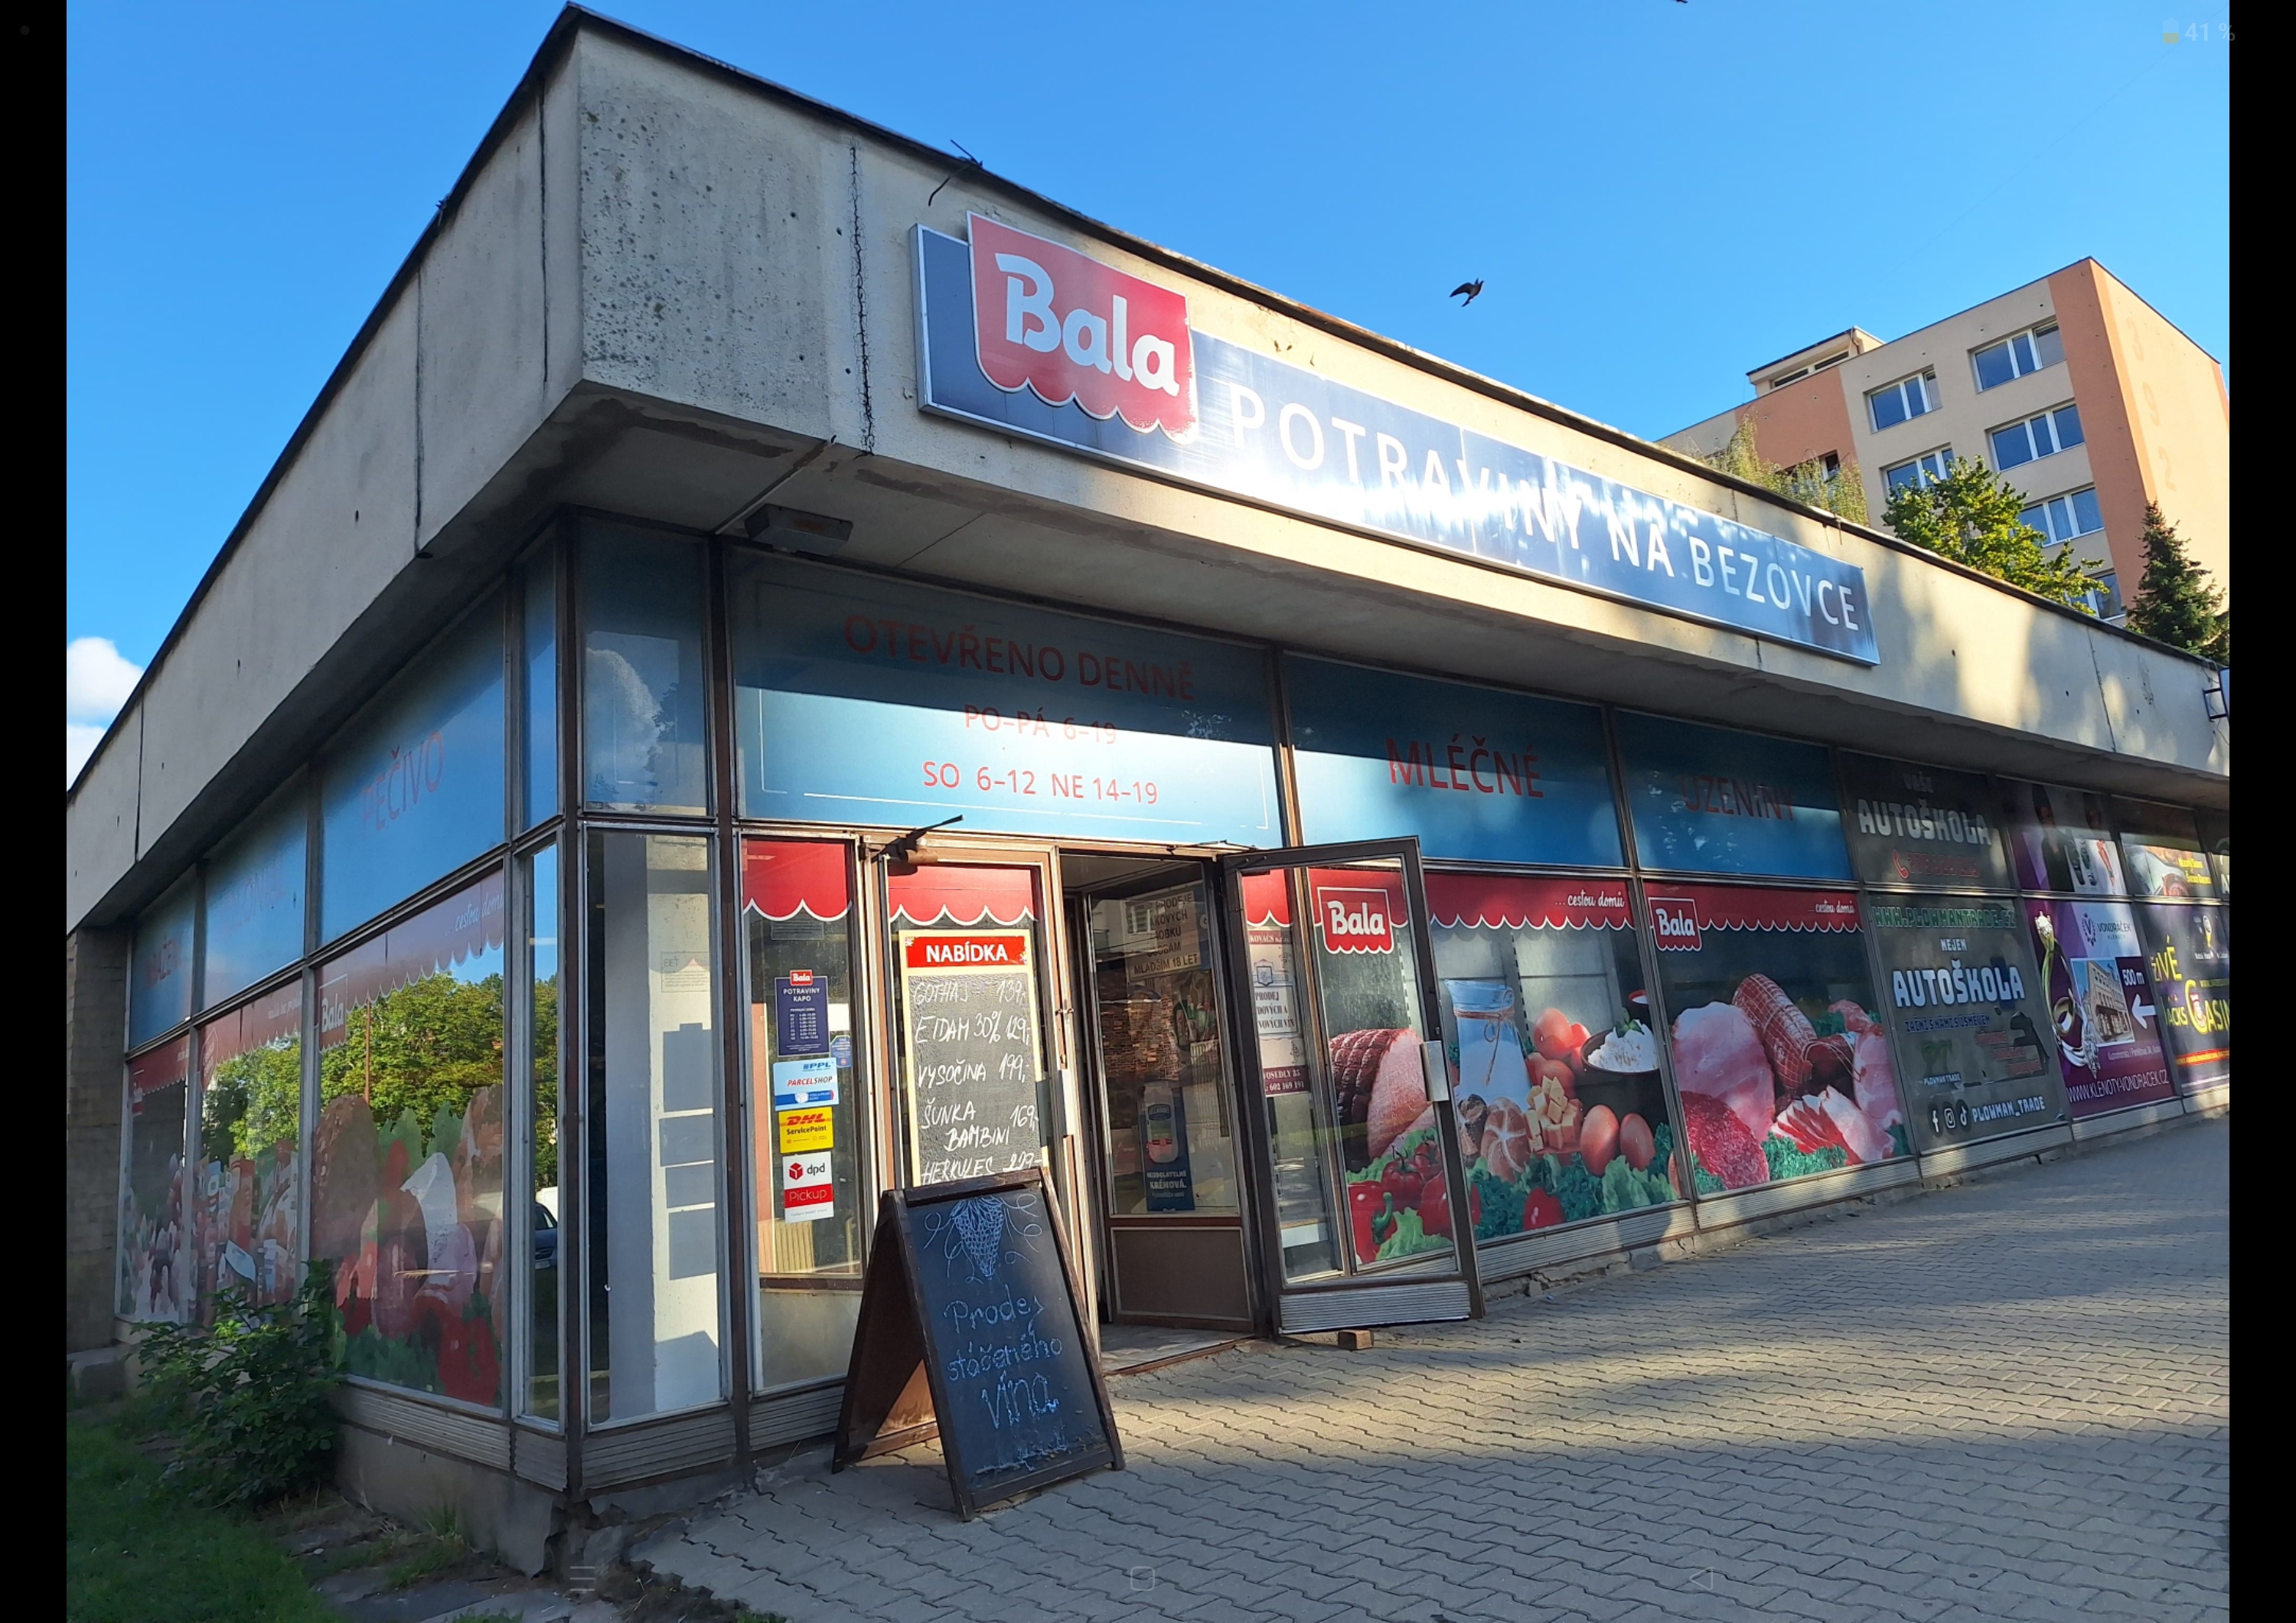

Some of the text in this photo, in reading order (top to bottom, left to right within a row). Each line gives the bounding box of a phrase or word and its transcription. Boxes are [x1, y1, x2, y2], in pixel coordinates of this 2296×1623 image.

[995, 252, 1180, 397] Bala
[1228, 381, 1859, 631] POTRAVINY NA BEZOVCE
[844, 615, 1195, 700] OTEVŘENO DENNĚ
[1386, 733, 1544, 798] MLÉČNÉ
[362, 731, 444, 840] PEČIVO
[921, 760, 1159, 805] SO 6-12 NE 14-19
[1681, 773, 1793, 821] UZENINY
[1857, 798, 1991, 846] AUTOŠKOLA
[1326, 900, 1386, 935] Bala
[1655, 908, 1696, 936] Bala
[925, 941, 1009, 963] NABÍDKA
[1940, 938, 1968, 951] NEJEN
[1172, 956, 1182, 968] 18
[1182, 953, 1199, 965] LET
[792, 972, 810, 981] Bala
[1893, 959, 2026, 1007] AUTOŠKOLA
[2122, 968, 2144, 986] 500 m
[913, 980, 969, 1004] GOTHAJ
[321, 993, 344, 1033] Bala
[915, 1015, 970, 1043] EIDAM
[974, 1010, 1002, 1044] 30%
[788, 1076, 833, 1086] PARCELSHOP
[918, 1058, 987, 1089] VYSOČINA
[787, 1113, 827, 1126] DHL
[921, 1097, 977, 1129] ŠUNKA
[1971, 1096, 2046, 1123] PLOWMAN_TRADE
[786, 1125, 827, 1135] ServicePoint
[944, 1124, 1010, 1152] BAMBINI
[807, 1163, 826, 1176] dpd
[789, 1189, 827, 1202] Pickup
